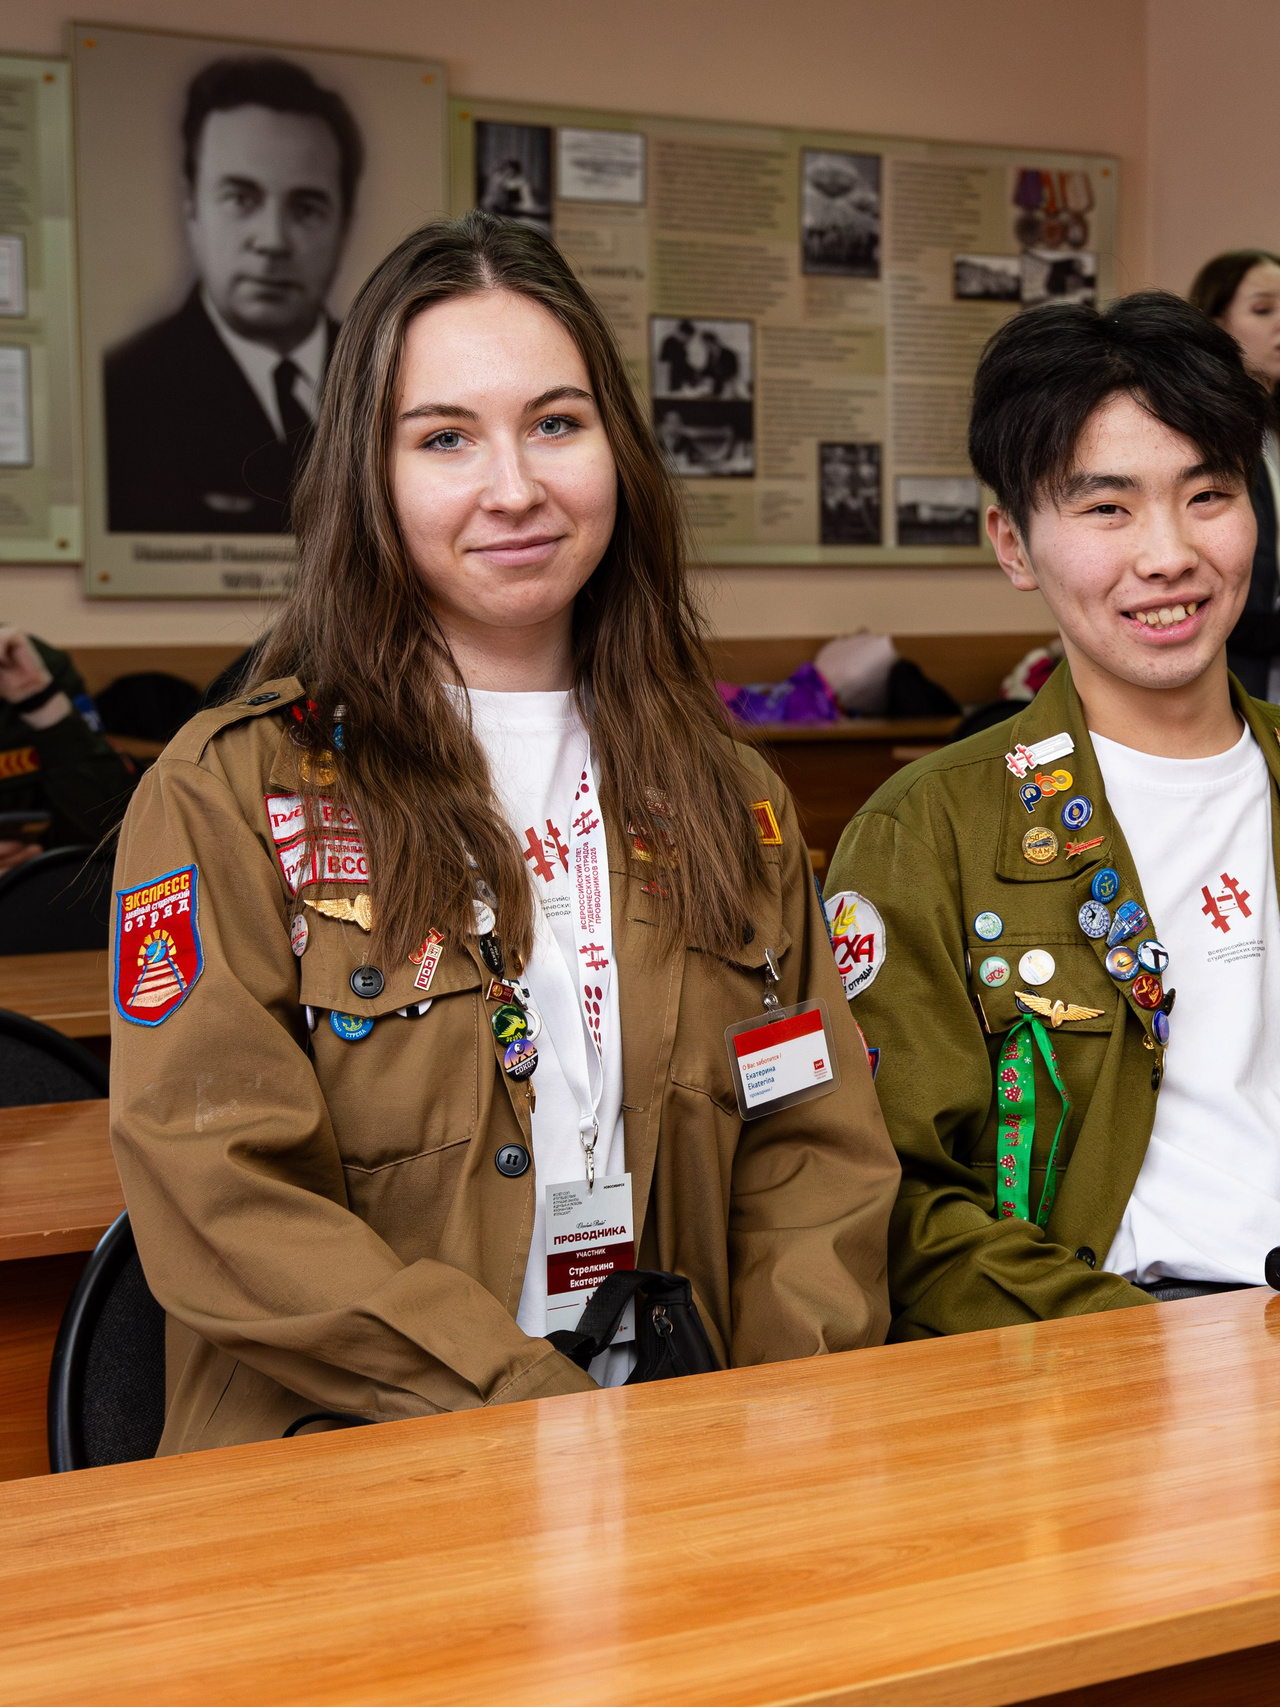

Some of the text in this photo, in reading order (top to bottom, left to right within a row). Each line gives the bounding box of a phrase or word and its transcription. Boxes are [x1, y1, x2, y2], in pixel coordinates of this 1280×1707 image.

[125, 874, 189, 911] ЭКСПРЕСС
[574, 864, 587, 930] ВСЕРОССИЙСКИЙ
[592, 865, 602, 924] ПРОВОДНИКОВ
[585, 875, 595, 933] СТУДЕНЧЕСКИХ
[848, 965, 874, 991] ОТРЯДЫ
[515, 1059, 536, 1075] СОКОЛ
[745, 1065, 776, 1081] Екатерина
[747, 1076, 775, 1091] Ekaterina
[553, 1226, 626, 1245] ПРОВОДНИКА
[576, 1248, 606, 1258] УЧАСТНИК
[569, 1262, 614, 1276] Стрелкина
